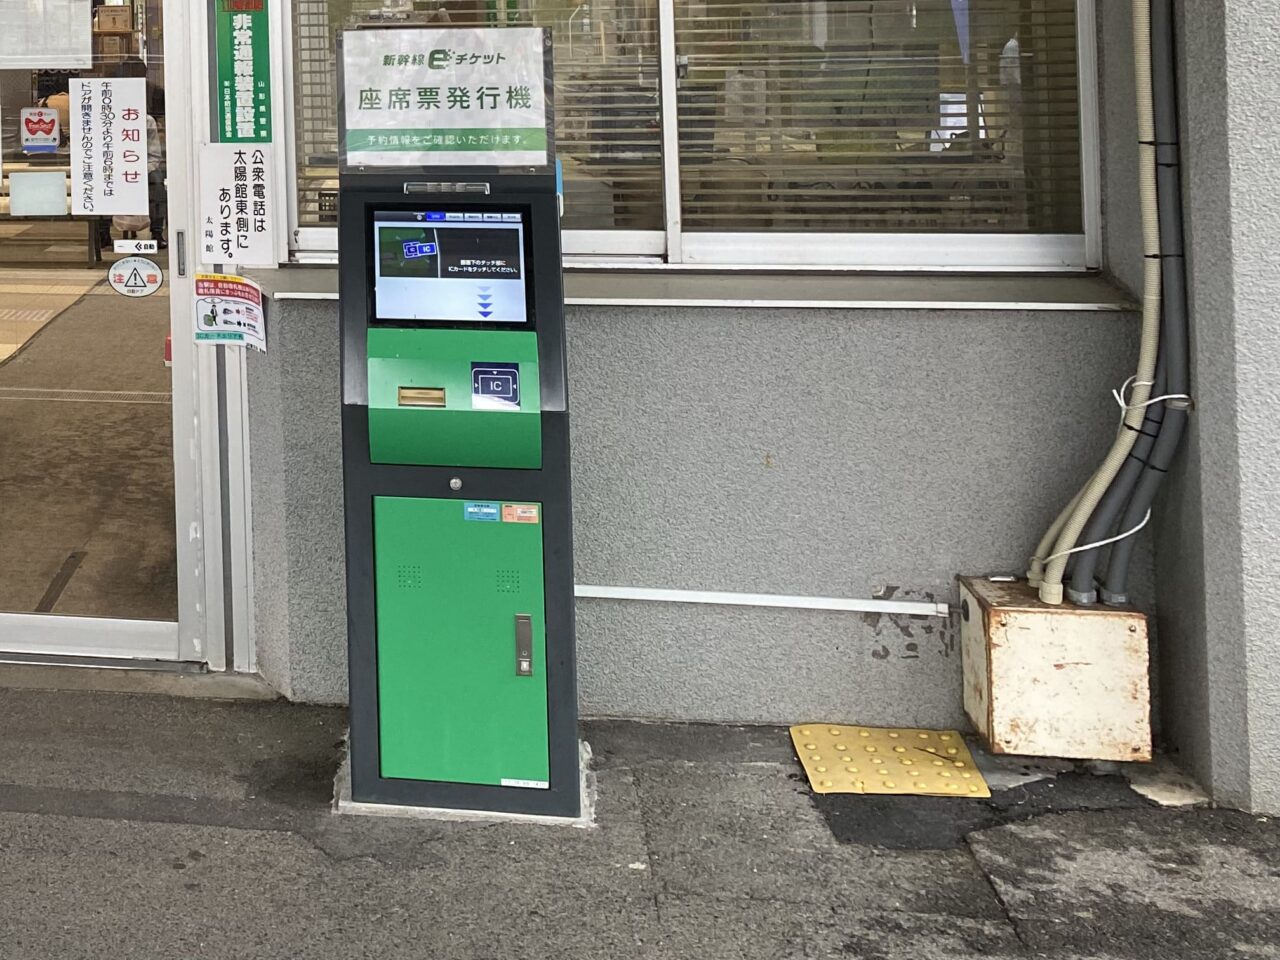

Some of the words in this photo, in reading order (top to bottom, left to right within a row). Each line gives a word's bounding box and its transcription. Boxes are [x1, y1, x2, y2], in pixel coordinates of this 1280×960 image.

[358, 85, 532, 111] 座席票発行機
[122, 107, 141, 184] お知らせ
[218, 187, 234, 259] あります。
[233, 149, 249, 249] 太陽館東側に
[251, 149, 267, 233] 公衆電話は
[423, 245, 431, 253] IC
[490, 381, 502, 391] IC
